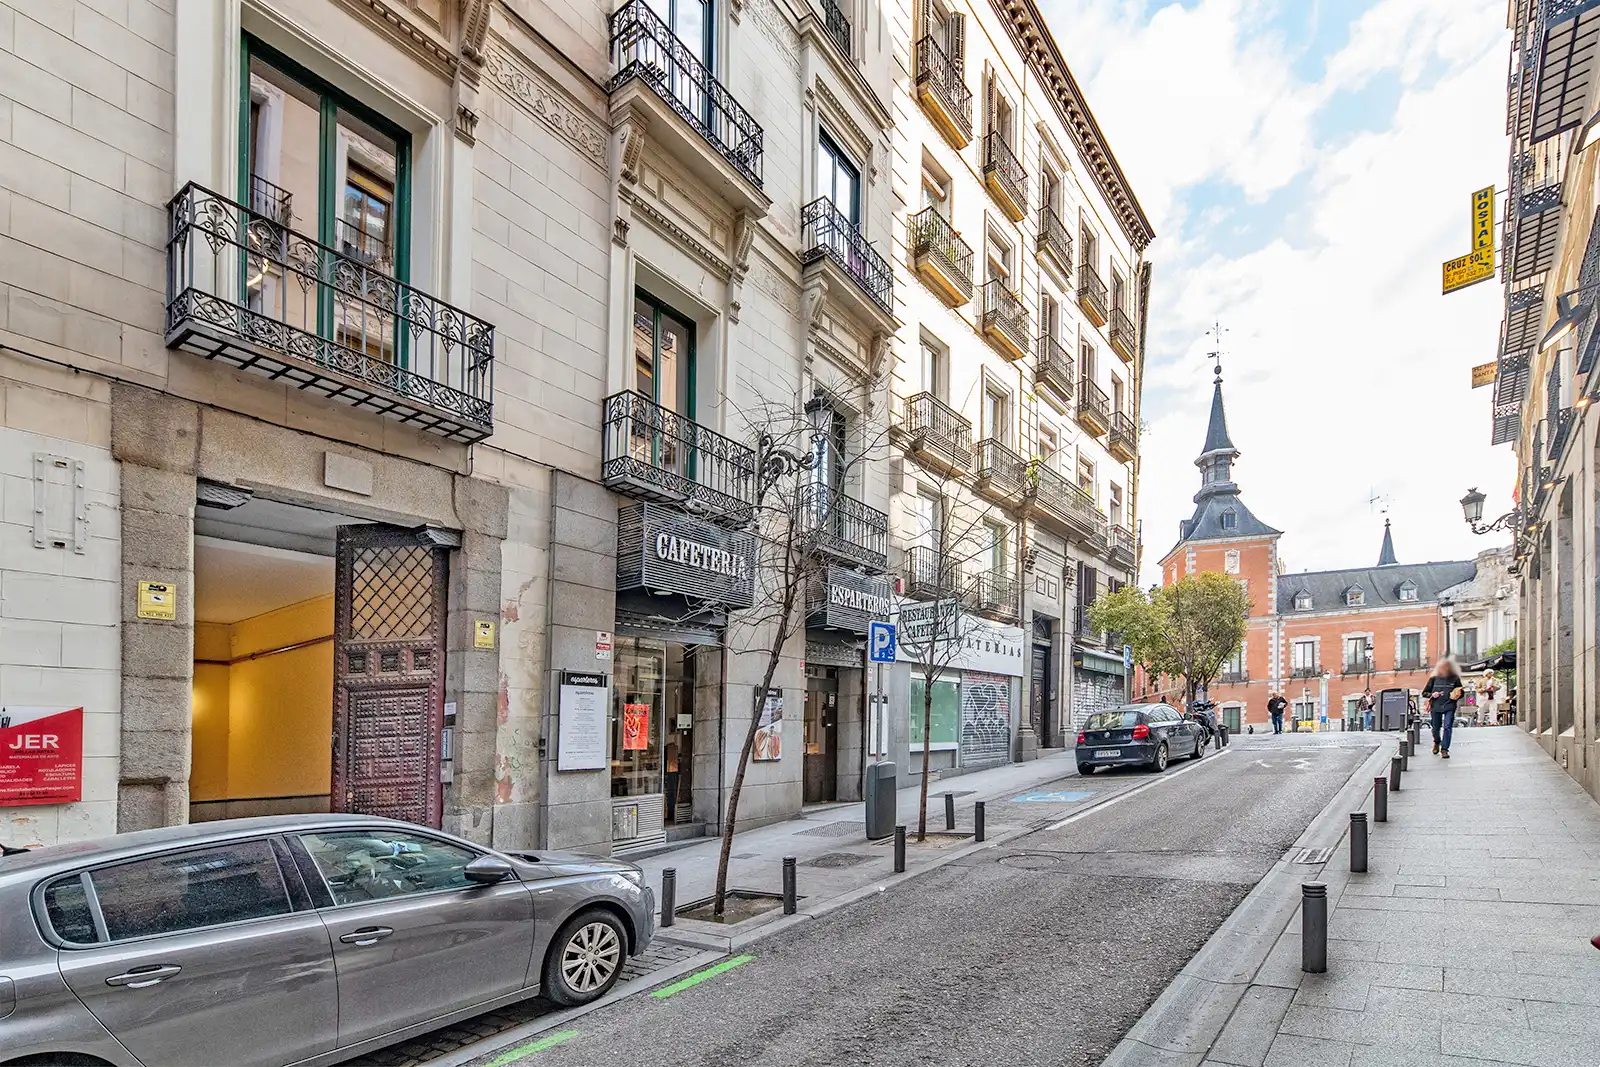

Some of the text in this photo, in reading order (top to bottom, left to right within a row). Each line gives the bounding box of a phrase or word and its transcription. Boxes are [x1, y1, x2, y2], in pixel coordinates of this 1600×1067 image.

[1477, 190, 1489, 247] HOSTAL
[1446, 251, 1483, 272] CRUZ SOL
[656, 532, 747, 580] CAFETERIA
[831, 584, 890, 616] ESPARTEROS
[874, 626, 890, 658] P
[9, 734, 60, 749] JER
